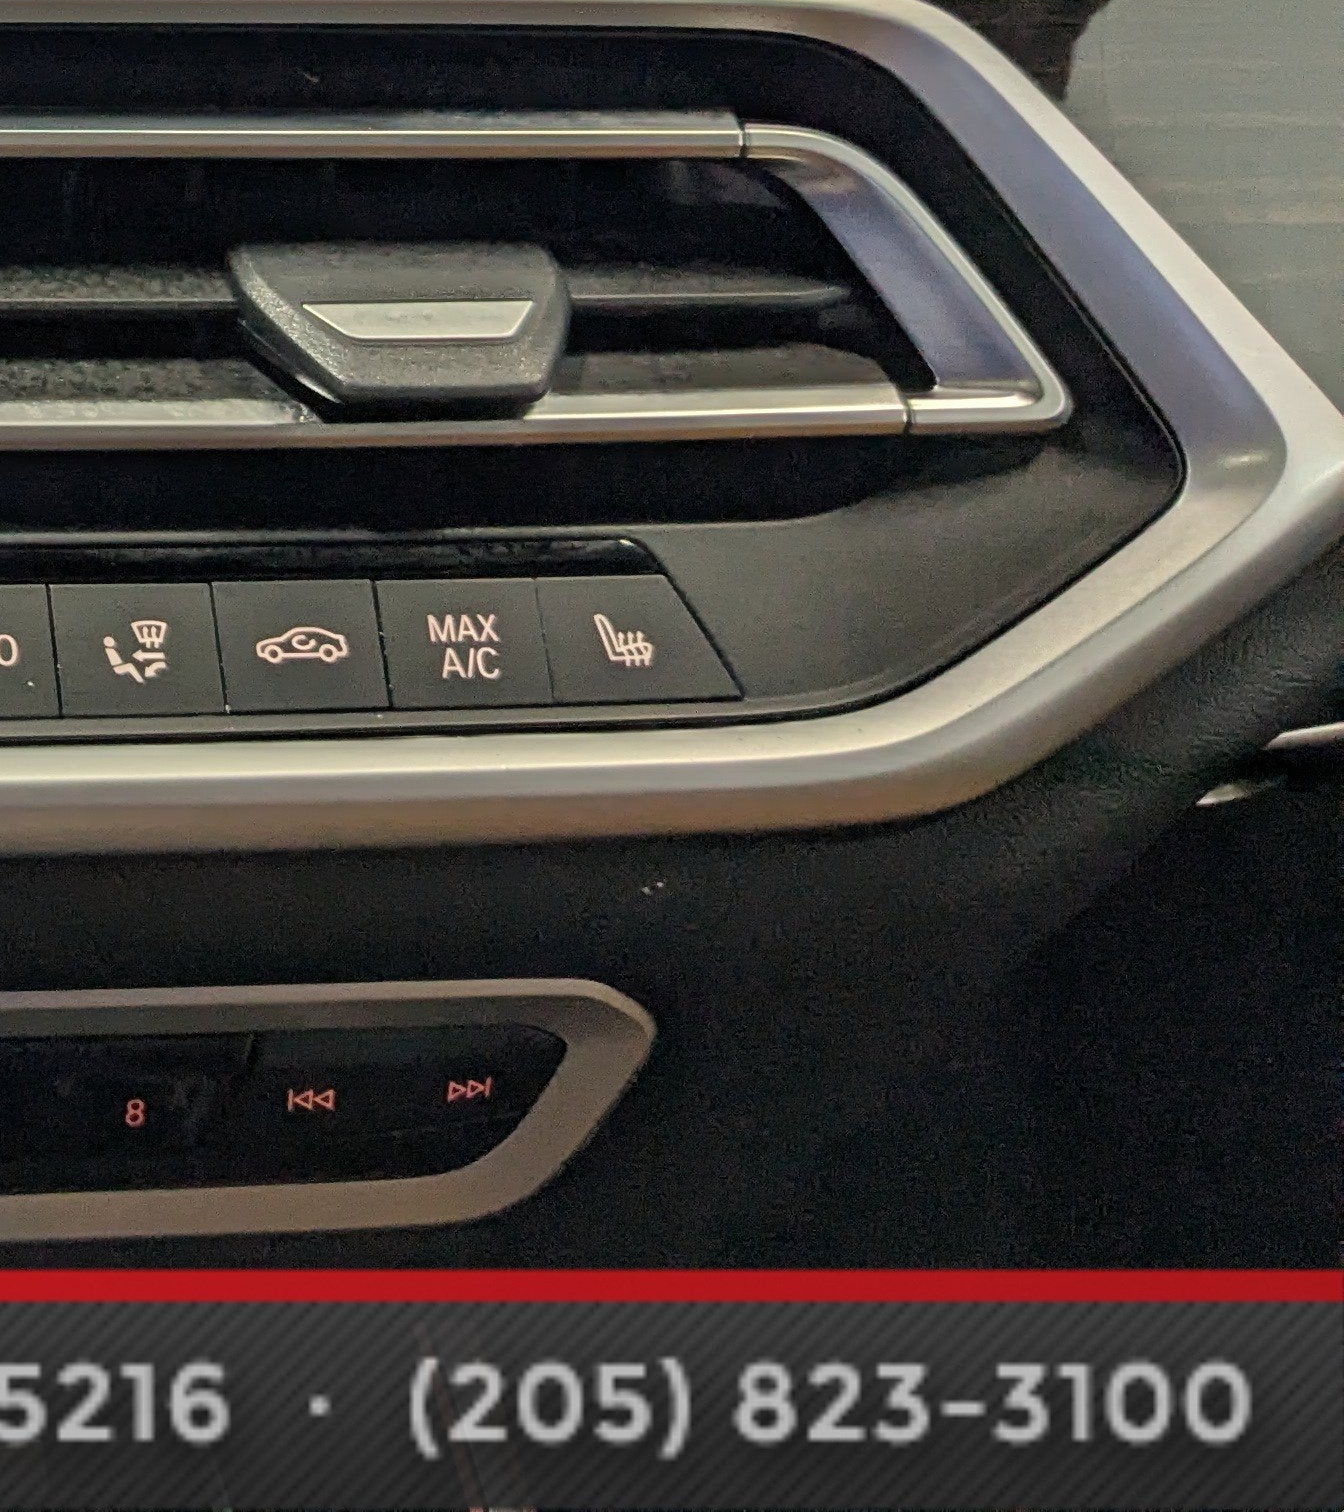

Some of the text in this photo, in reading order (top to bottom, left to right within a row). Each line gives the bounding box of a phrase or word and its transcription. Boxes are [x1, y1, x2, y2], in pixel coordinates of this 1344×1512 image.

[426, 613, 501, 644] MAX
[440, 645, 502, 680] A/C
[124, 1098, 147, 1128] 8
